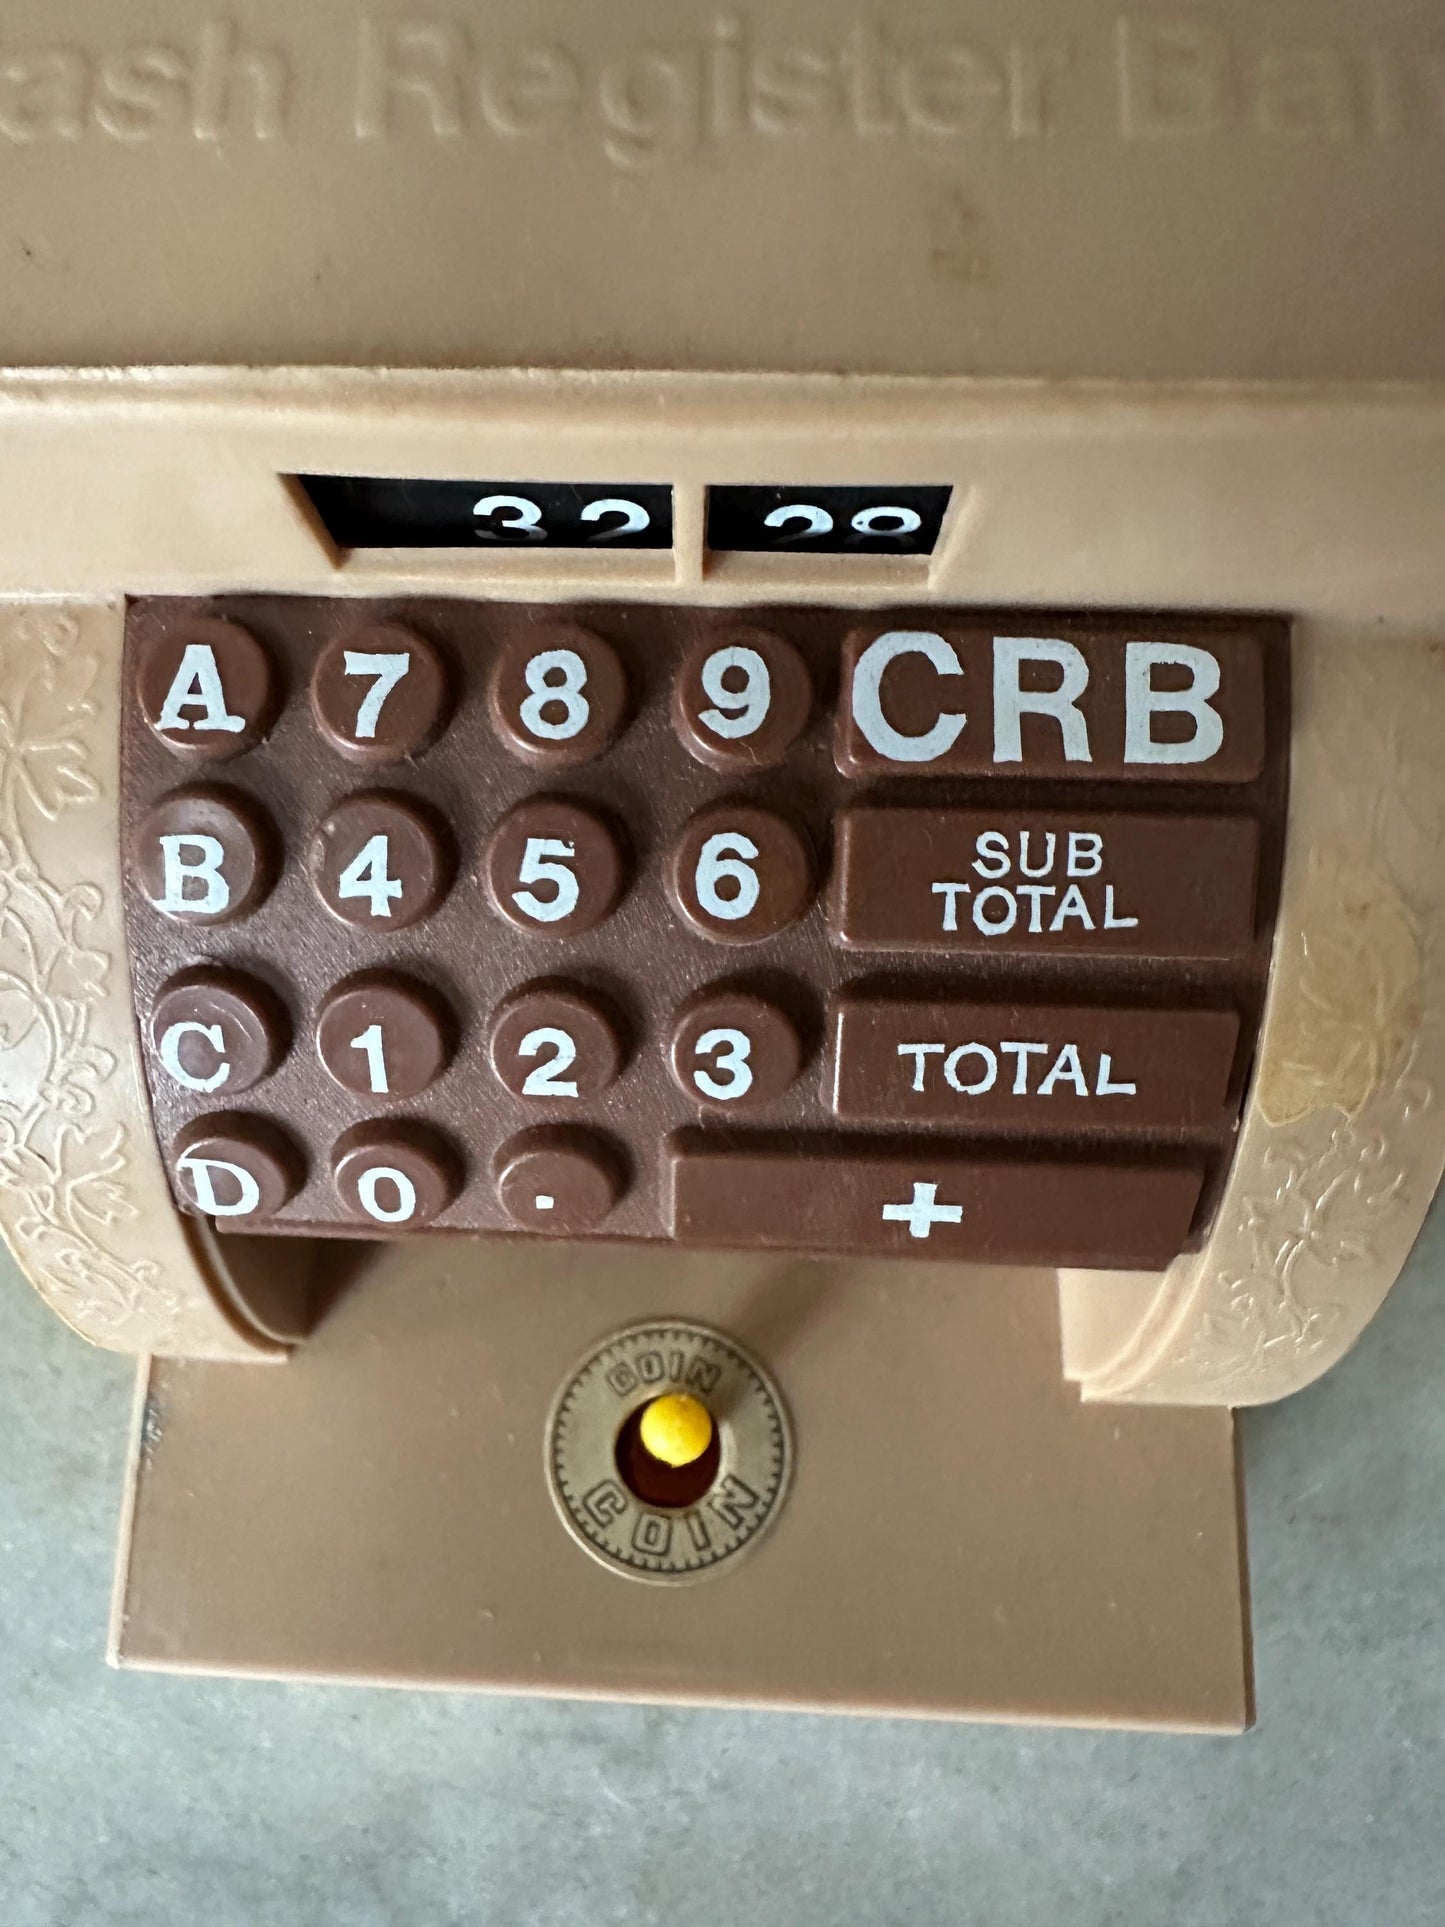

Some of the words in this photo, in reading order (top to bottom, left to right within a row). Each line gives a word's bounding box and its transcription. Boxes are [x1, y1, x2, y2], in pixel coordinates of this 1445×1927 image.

[353, 13, 1076, 167] Register
[157, 644, 246, 733] A
[344, 650, 410, 738] 7
[519, 649, 590, 740] 8
[698, 646, 771, 739] 9
[852, 631, 1224, 765] CRB
[158, 833, 230, 915] B
[338, 835, 403, 918] 4
[511, 837, 580, 923] 5
[695, 832, 760, 920] 6
[971, 831, 1103, 879] SUB
[931, 882, 1138, 936] TOTAL
[160, 1020, 231, 1093] C
[350, 1024, 389, 1094] 1
[517, 1027, 579, 1098] 2
[693, 1028, 754, 1101] 3
[897, 1041, 1137, 1097] TOTAL
[176, 1157, 260, 1217] D
[604, 1350, 722, 1397] COIN
[581, 1473, 760, 1557] COIN
